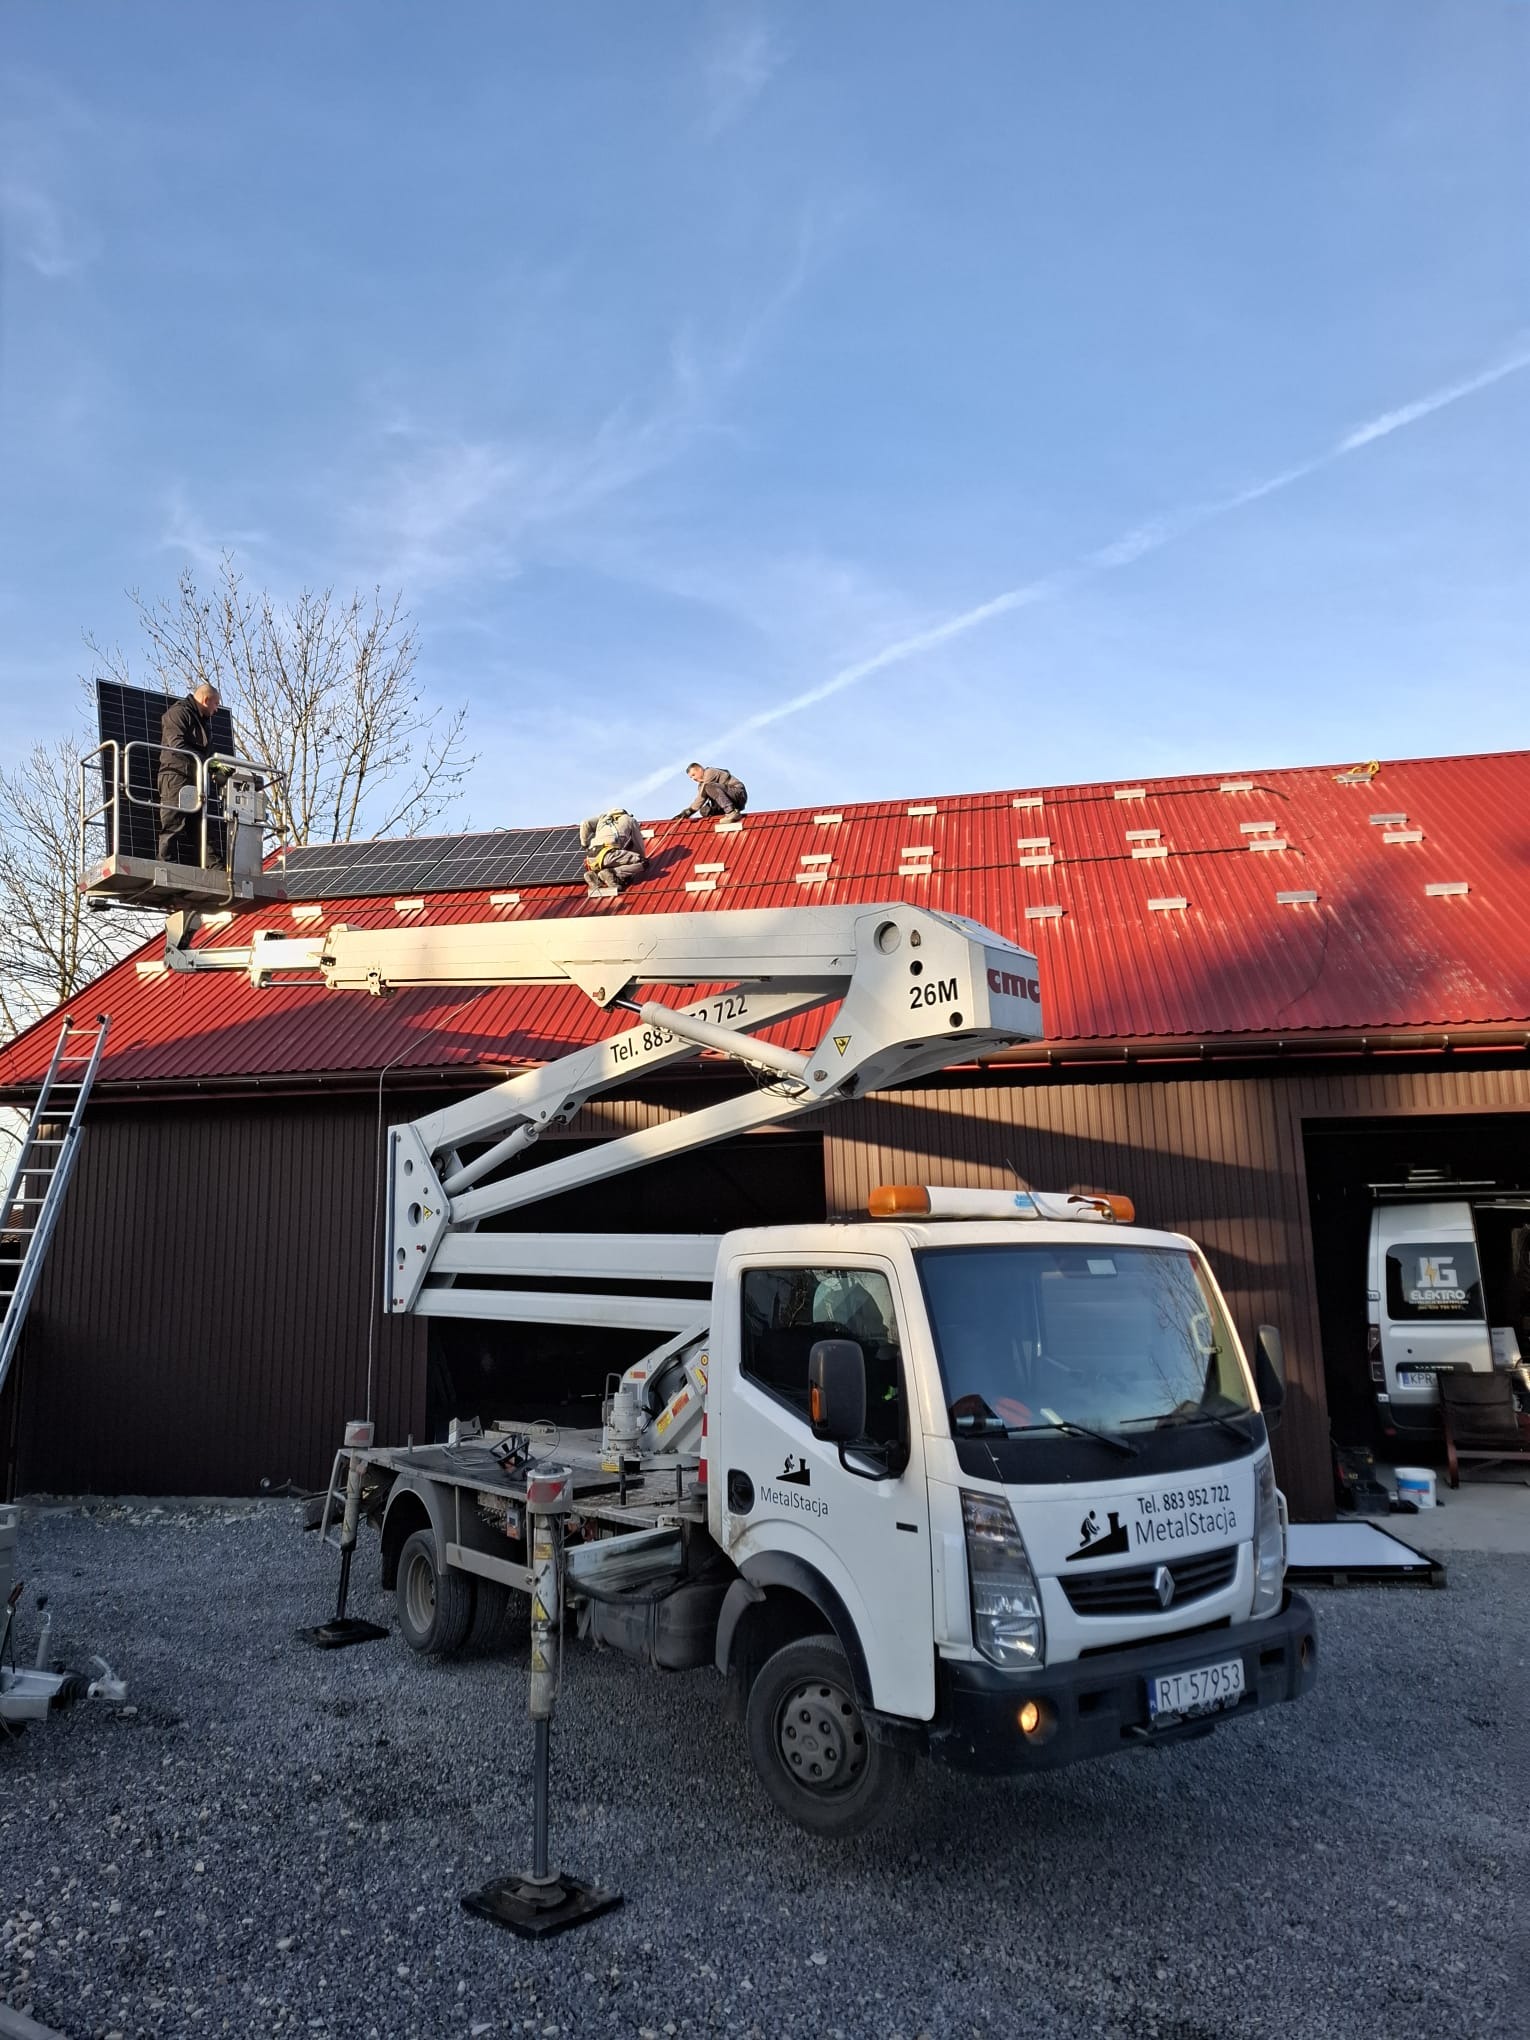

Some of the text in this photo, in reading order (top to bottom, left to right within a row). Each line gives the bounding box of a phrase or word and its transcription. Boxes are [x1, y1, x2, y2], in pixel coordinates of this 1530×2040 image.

[909, 978, 959, 1010] 26M
[610, 1037, 639, 1064] Tel.
[713, 994, 748, 1024] 722
[1410, 1290, 1466, 1300] ELEKTRO
[1410, 1373, 1434, 1385] KPR
[760, 1486, 829, 1517] MetalStacja
[1137, 1484, 1231, 1515] Tel. 883 952 722
[1135, 1507, 1237, 1545] MetalStacja
[1160, 1663, 1241, 1709] RT 57953
